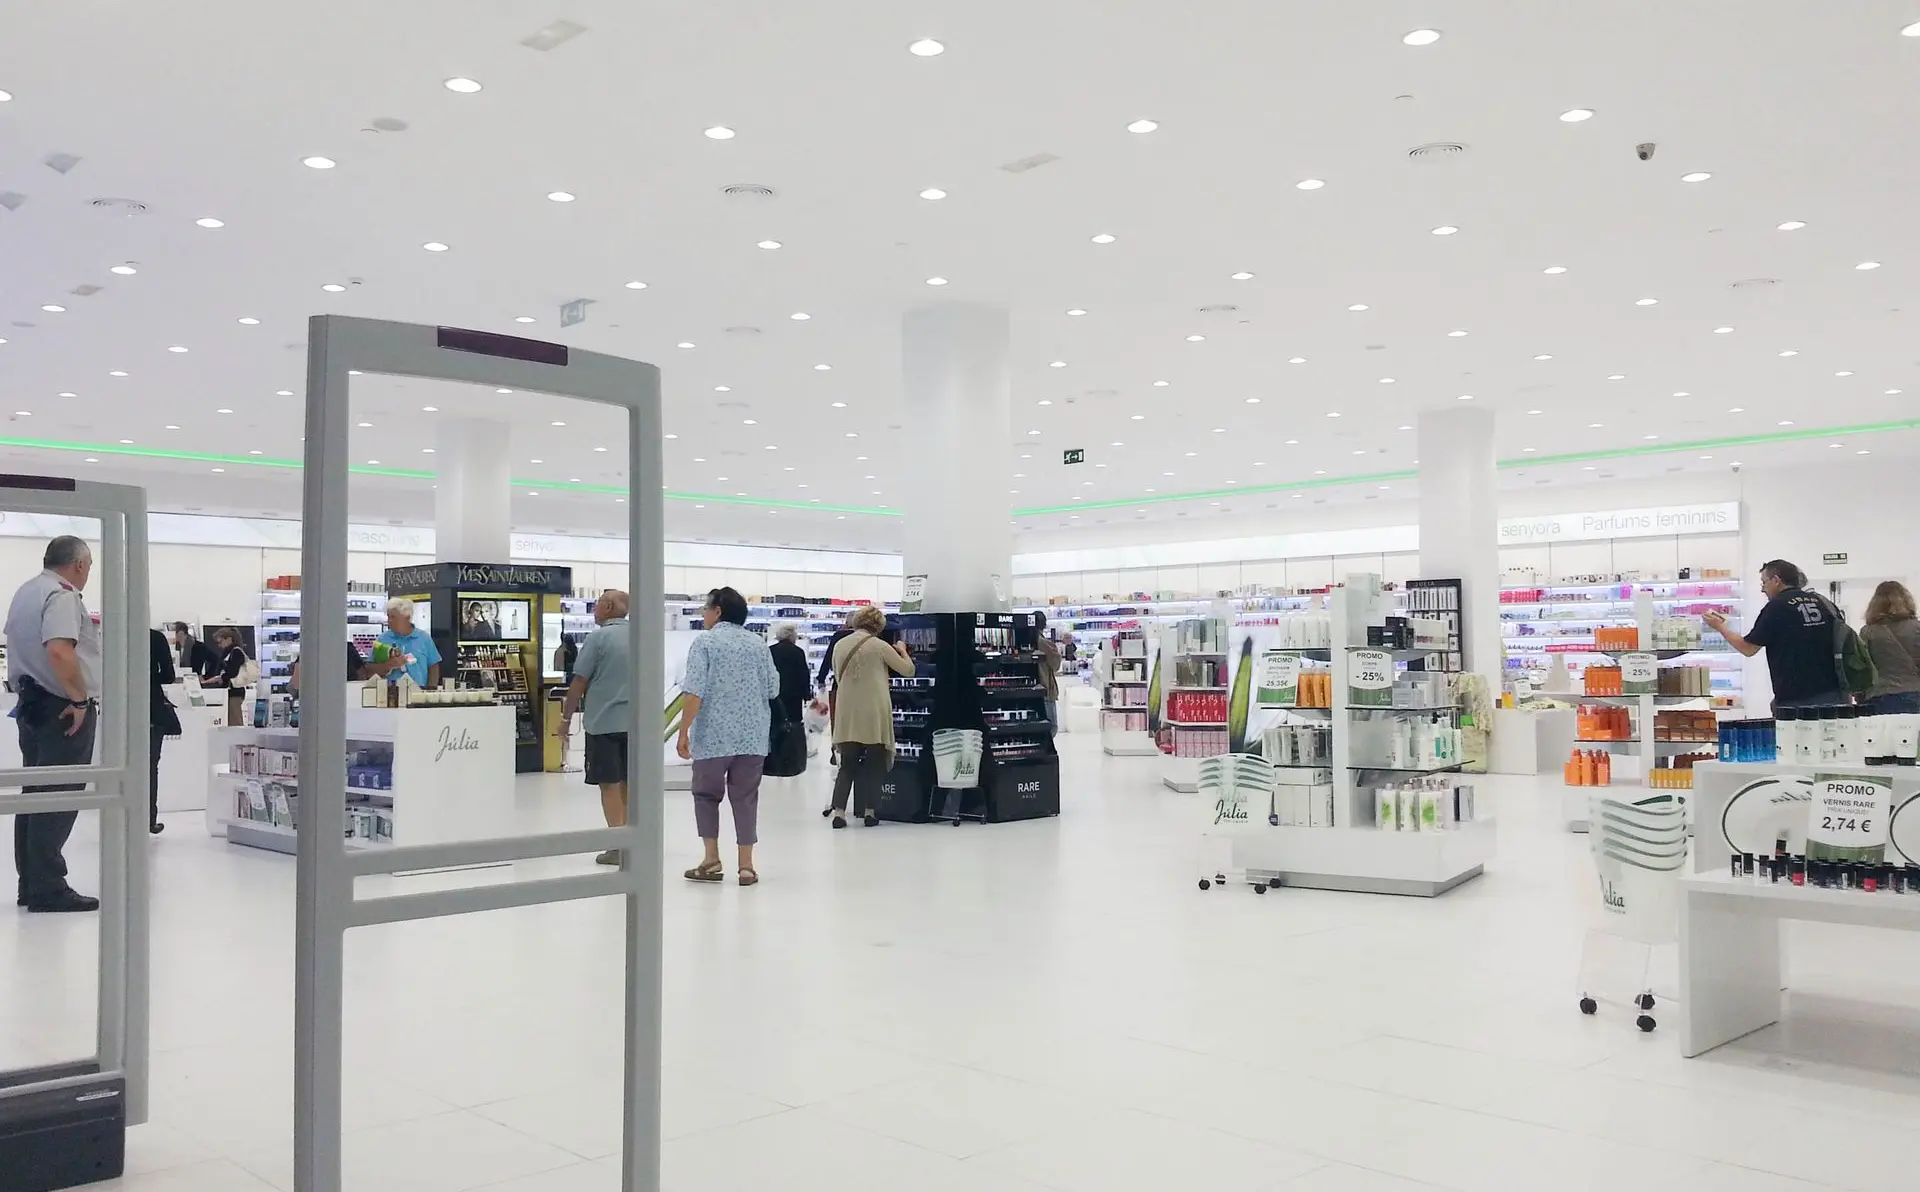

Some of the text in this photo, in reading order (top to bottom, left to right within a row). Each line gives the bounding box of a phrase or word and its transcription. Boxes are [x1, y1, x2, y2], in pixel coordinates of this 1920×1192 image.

[1501, 519, 1561, 537] senyora
[1582, 513, 1650, 532] Parfums
[1797, 603, 1822, 623] 15
[1356, 652, 1383, 660] PROMO
[1362, 671, 1384, 682] 25%
[435, 725, 479, 762] Júlia
[1018, 781, 1040, 793] RARE
[1827, 783, 1875, 796] PROMO
[1214, 799, 1248, 825] Júlia
[1823, 799, 1876, 809] VERNIS RARE
[1821, 816, 1872, 833] 2,74 €
